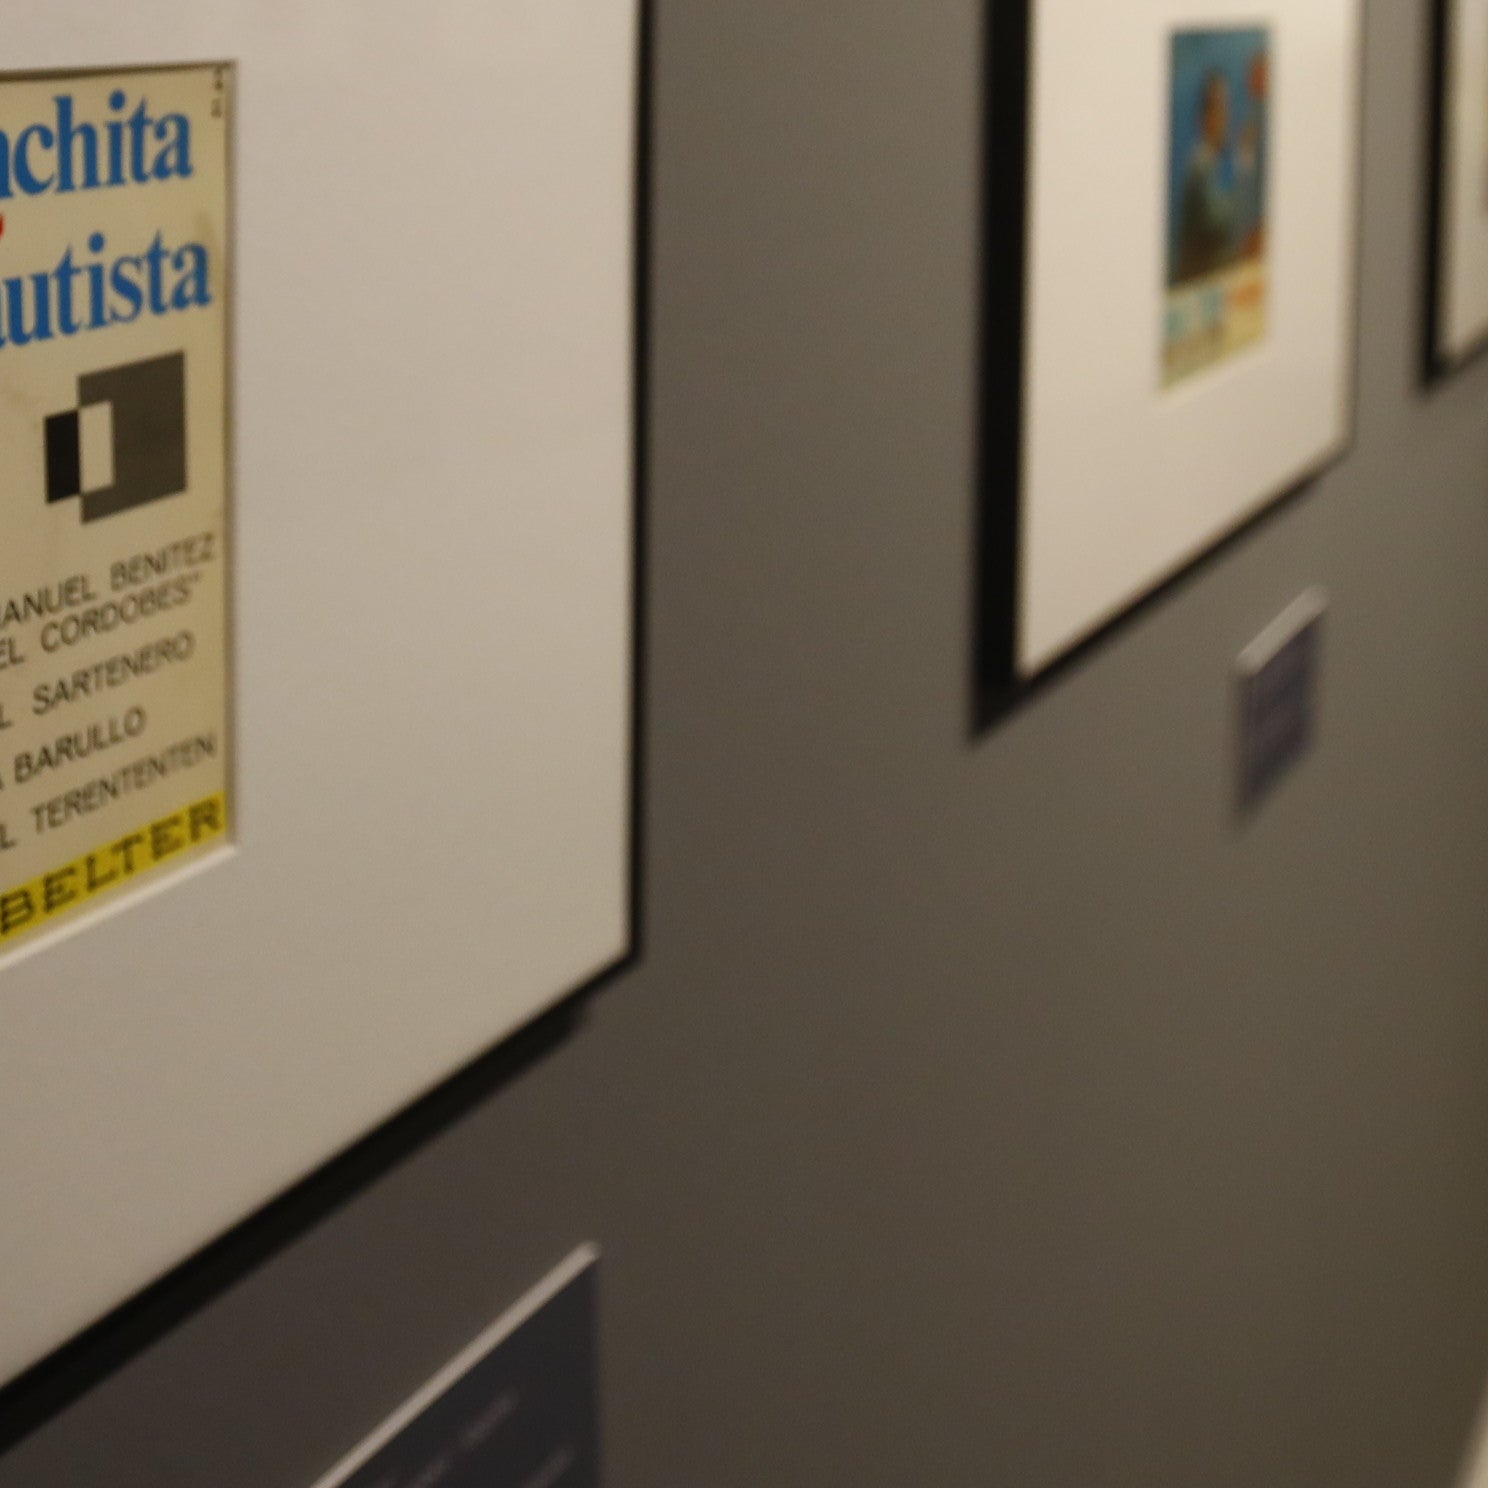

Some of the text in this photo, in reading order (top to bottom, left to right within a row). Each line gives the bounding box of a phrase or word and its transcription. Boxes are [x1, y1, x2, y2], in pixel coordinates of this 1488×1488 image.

[110, 531, 214, 591] BENITEZ
[32, 629, 197, 716] SARTENERO
[13, 705, 147, 784] BARULLO
[31, 733, 217, 834] TERENTENTEN
